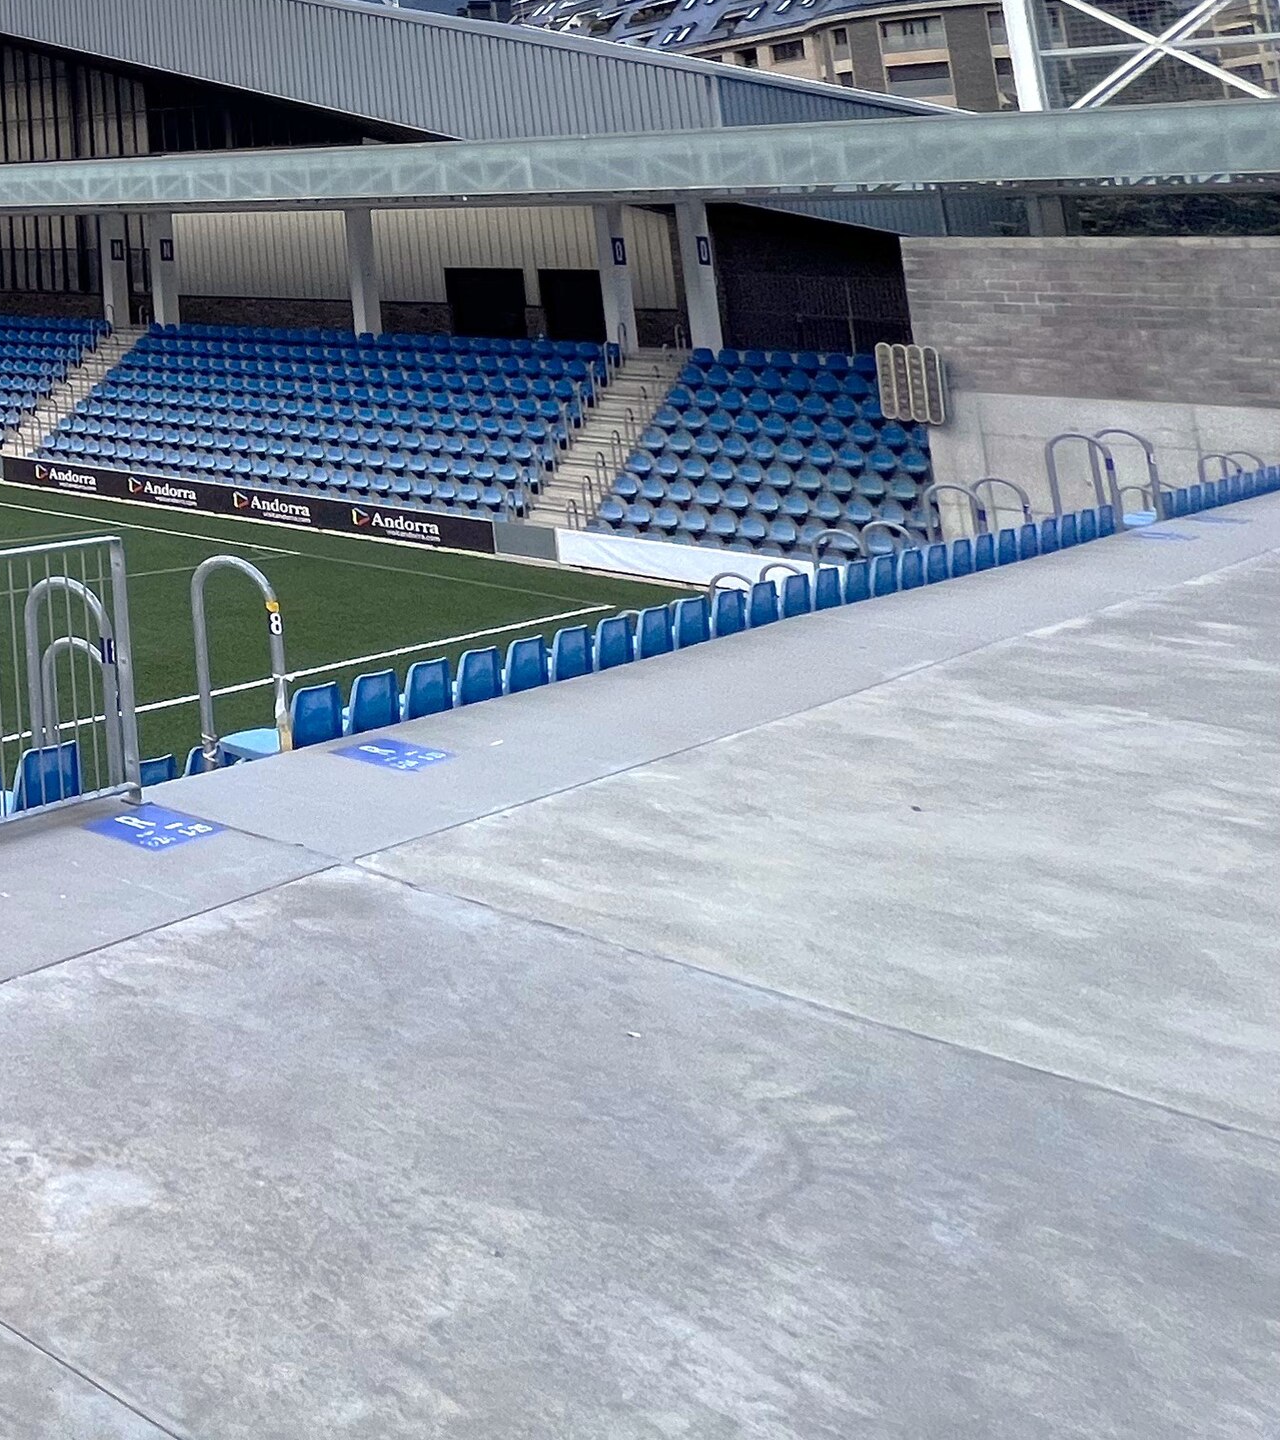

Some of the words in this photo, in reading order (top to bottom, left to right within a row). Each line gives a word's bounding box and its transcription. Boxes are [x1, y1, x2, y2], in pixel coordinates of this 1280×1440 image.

[49, 468, 97, 486] Andorra
[143, 481, 197, 500] Andorra
[250, 495, 310, 517] Andorra
[371, 513, 440, 535] Andorra
[270, 613, 283, 635] 8
[114, 815, 157, 829] R
